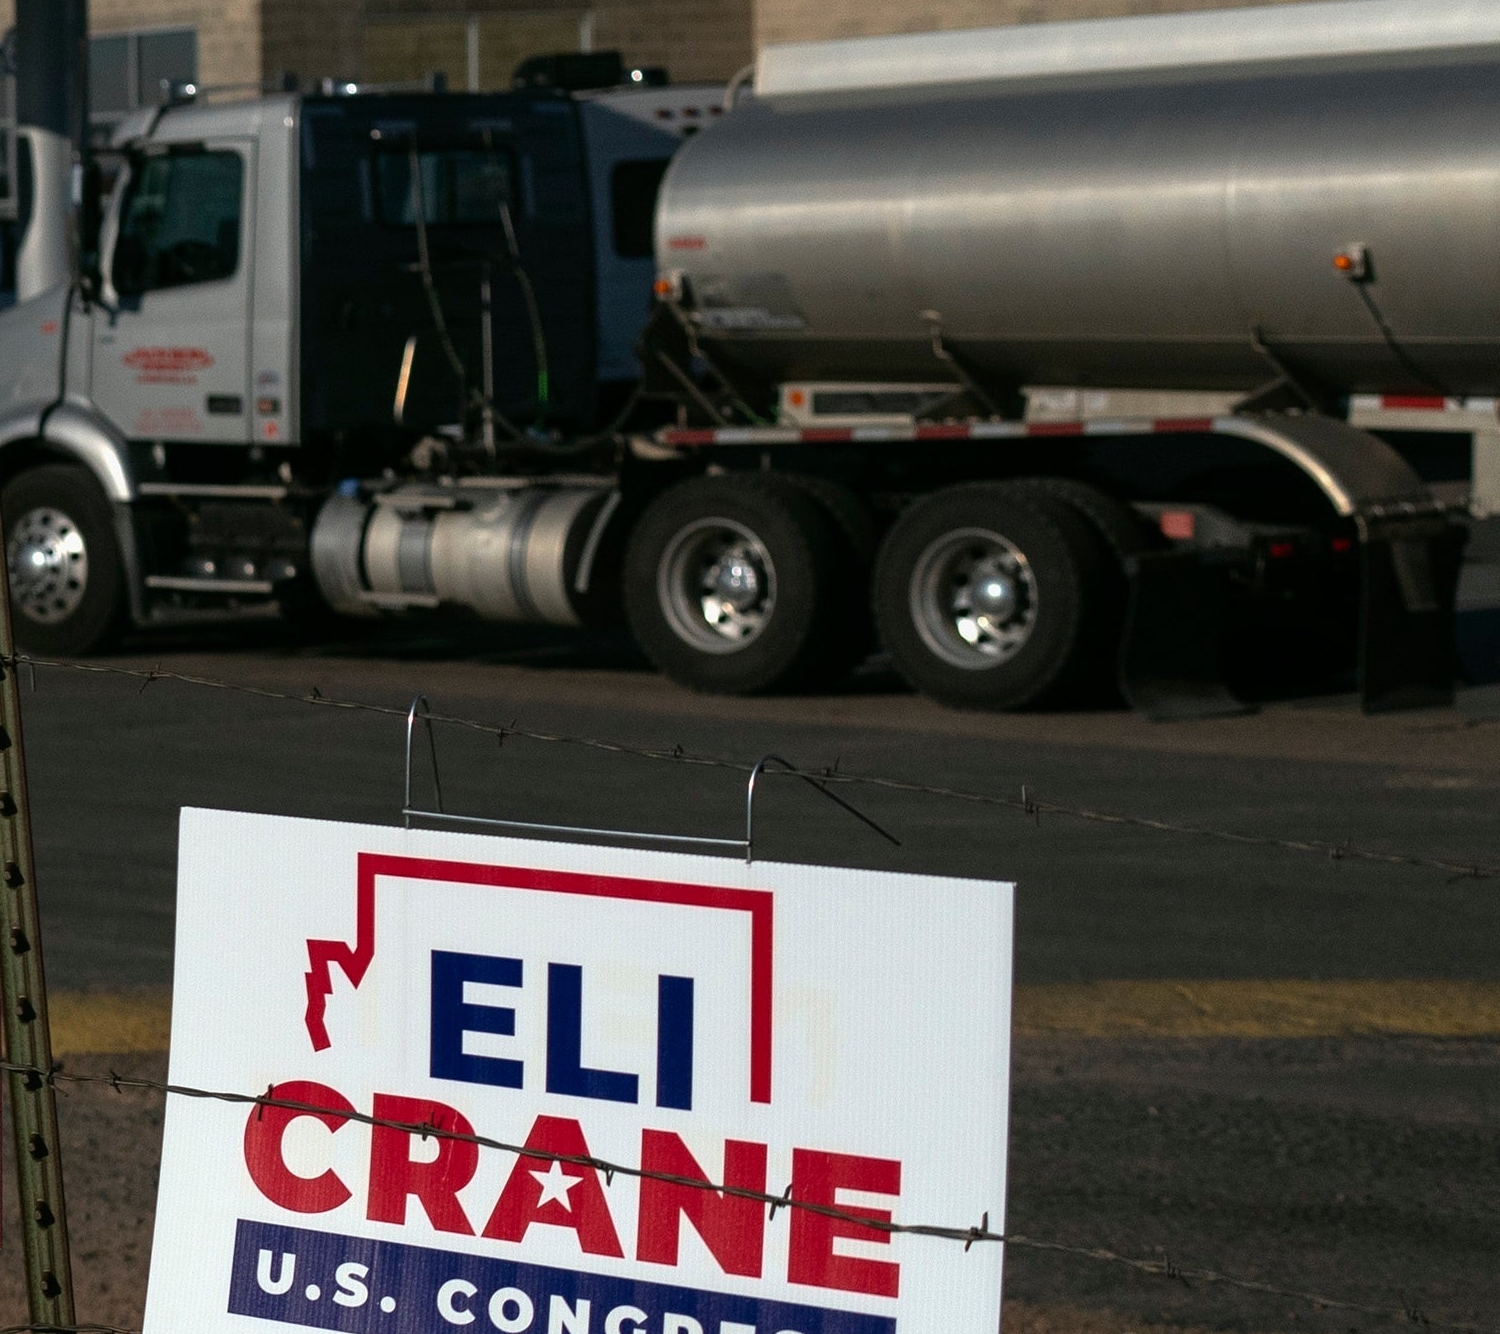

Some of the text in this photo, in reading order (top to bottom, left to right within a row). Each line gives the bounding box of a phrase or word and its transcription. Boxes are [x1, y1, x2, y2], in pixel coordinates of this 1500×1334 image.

[429, 949, 695, 1111] ELI
[243, 1078, 902, 1299] CRANE
[254, 1248, 396, 1313] U.S.
